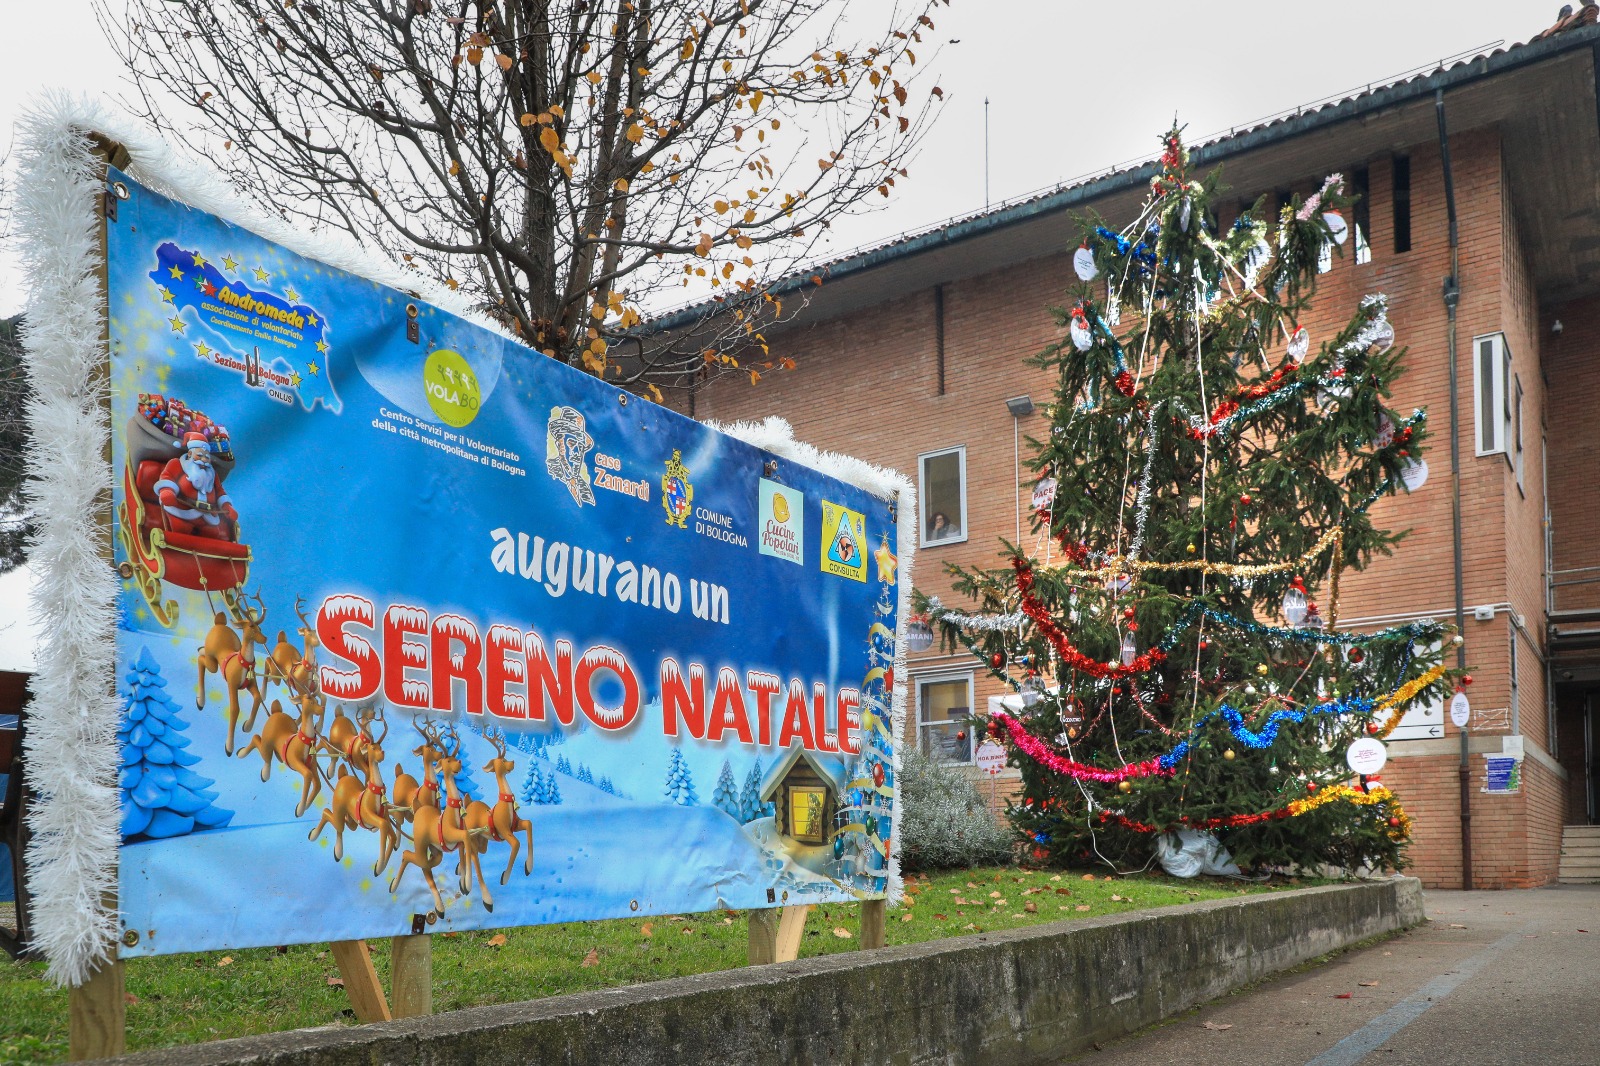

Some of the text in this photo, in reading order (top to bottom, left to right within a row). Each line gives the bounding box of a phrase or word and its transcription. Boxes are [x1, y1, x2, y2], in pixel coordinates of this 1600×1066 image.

[201, 302, 303, 340] associazione di volontariato
[218, 286, 304, 329] Andromeda
[210, 316, 252, 335] Coordinamento
[214, 353, 289, 386] Sezione di Bologna
[269, 389, 292, 403] ONLUS
[371, 418, 526, 477] della città metropolitana di Bologna
[379, 407, 413, 424] Centro
[415, 418, 442, 436] Servizi
[443, 431, 458, 442] per
[466, 437, 520, 462] Volontariato
[595, 453, 621, 471] case
[594, 467, 649, 502] Zanardi
[1033, 486, 1054, 500] PACE
[696, 507, 733, 529] COMUNE
[766, 519, 795, 541] Cucine
[696, 522, 748, 548] DI BOLOGNA
[762, 531, 799, 555] Popolari
[490, 527, 730, 625] augurano un
[829, 563, 860, 579] CONSULTA
[315, 593, 640, 731] SERENO
[660, 656, 861, 756] NATALE
